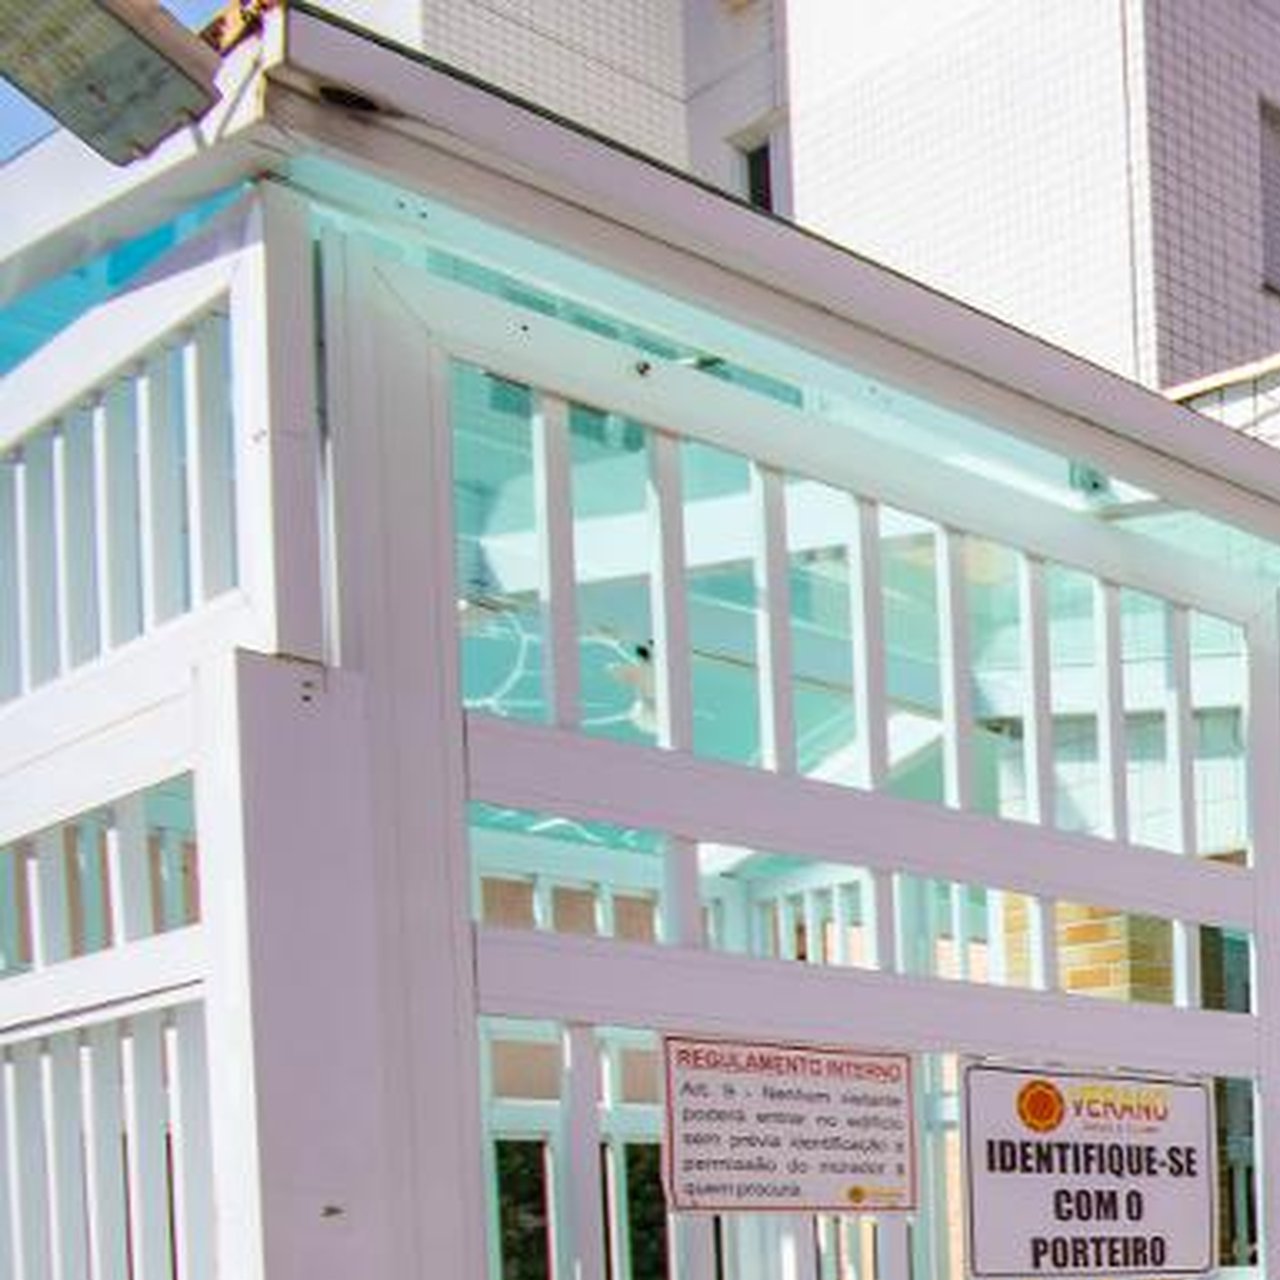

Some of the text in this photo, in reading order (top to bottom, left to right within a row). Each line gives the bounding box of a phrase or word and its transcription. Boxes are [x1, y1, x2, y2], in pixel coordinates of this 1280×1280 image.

[677, 1048, 902, 1084] REGULAMENTO INTERNO
[762, 1084, 832, 1105] Nenhum
[986, 1138, 1199, 1178] IDENTIFIQUE-SE
[1053, 1188, 1143, 1222] COM O
[1030, 1235, 1167, 1270] PORTEIRO
